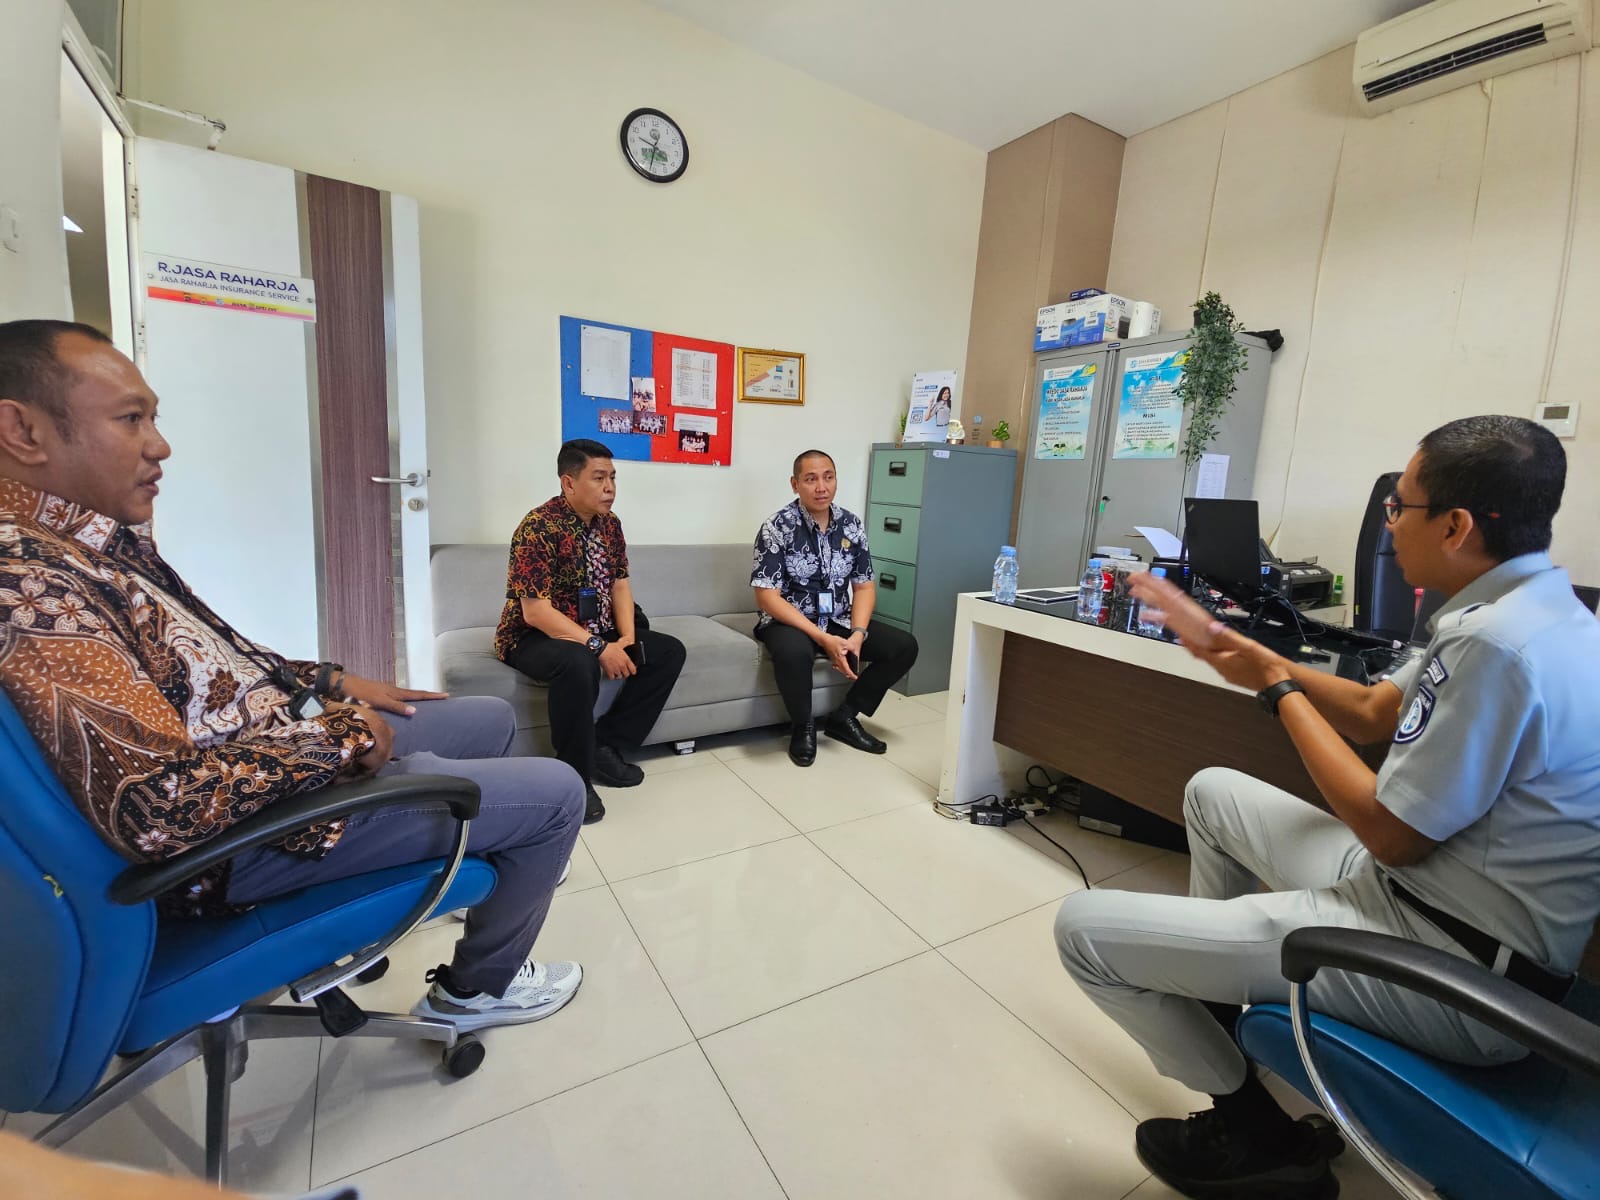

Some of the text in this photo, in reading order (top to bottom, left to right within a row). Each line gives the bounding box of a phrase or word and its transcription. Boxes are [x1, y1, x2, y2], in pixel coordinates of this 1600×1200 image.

[158, 261, 300, 293] R.JASA RAHARJA
[160, 276, 300, 302] JASA RAHARJA INSURANCE SERVICE
[1039, 306, 1056, 315] EPSON
[1110, 297, 1126, 307] EPSON
